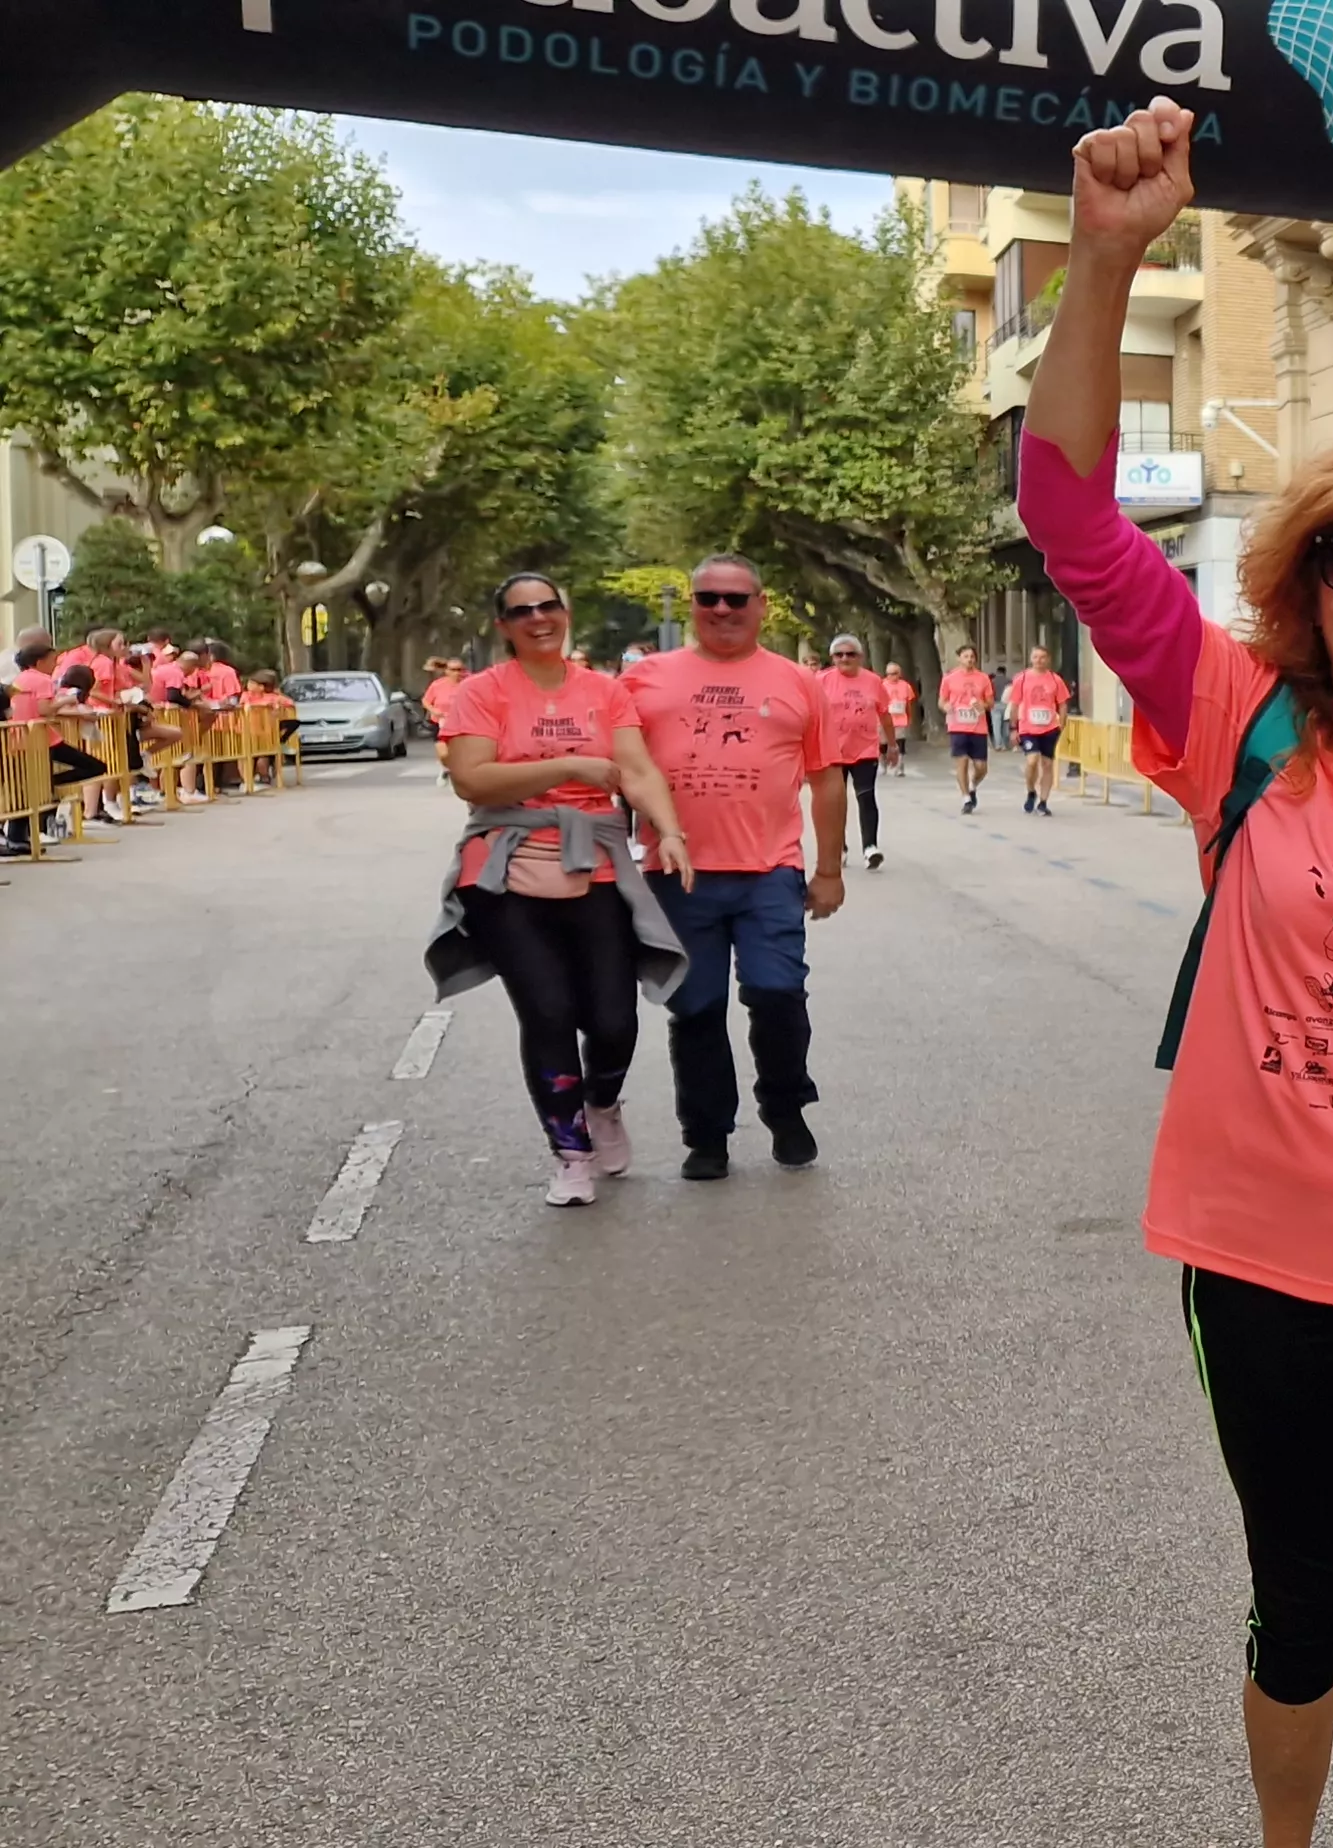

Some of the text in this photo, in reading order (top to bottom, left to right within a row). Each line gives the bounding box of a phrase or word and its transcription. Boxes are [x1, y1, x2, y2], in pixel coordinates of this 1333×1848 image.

[406, 13, 1223, 145] PODOLOGÍA Y BIOMECÁNA
